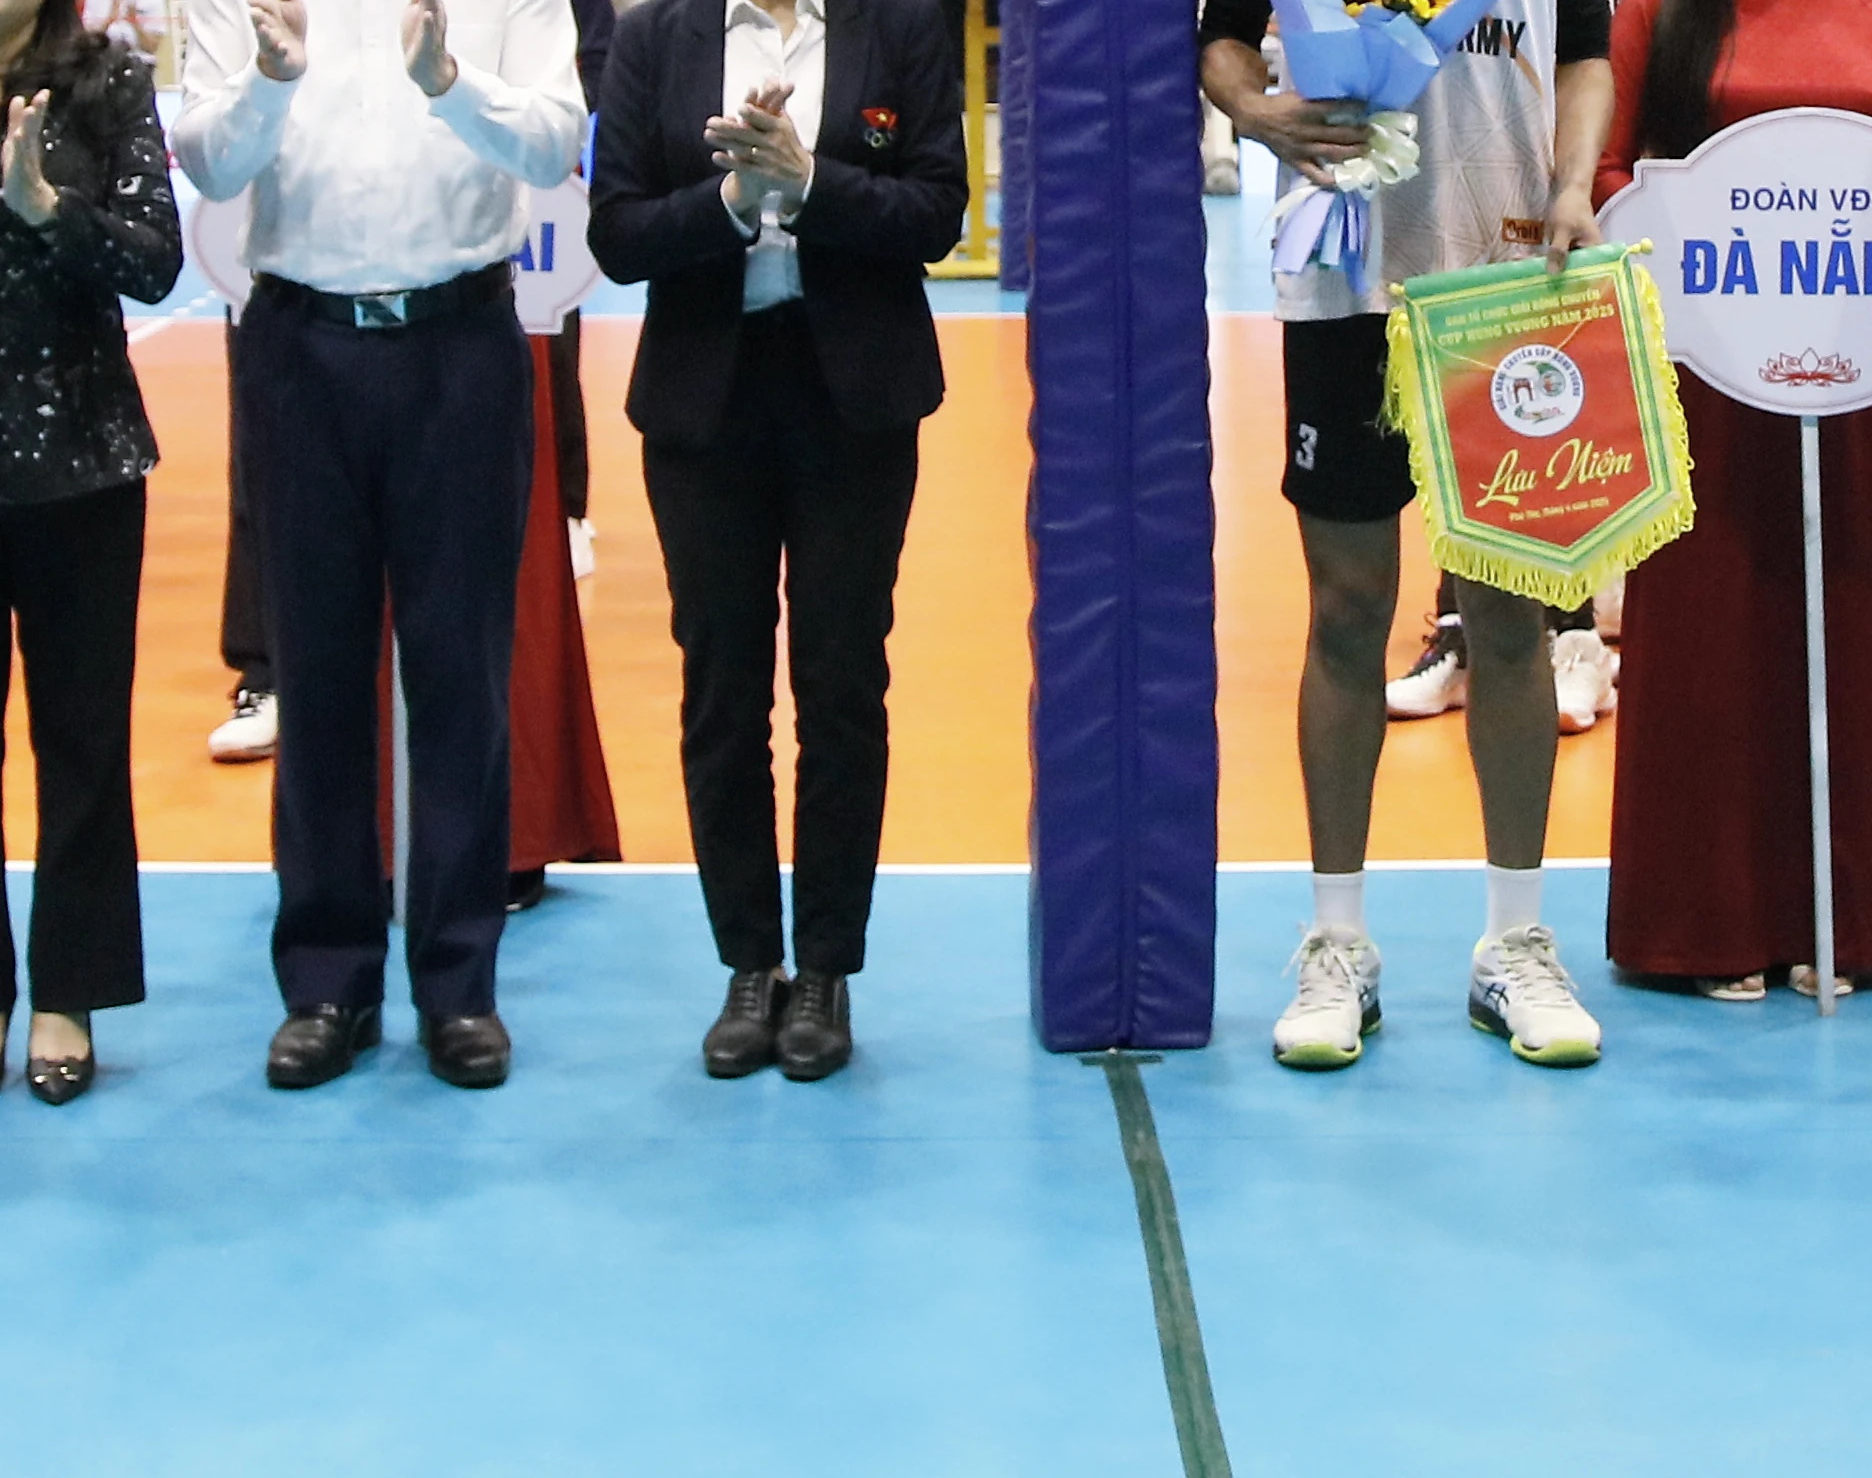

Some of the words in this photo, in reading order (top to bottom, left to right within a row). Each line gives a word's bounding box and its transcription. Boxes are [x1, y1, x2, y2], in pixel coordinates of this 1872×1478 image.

[1730, 182, 1817, 211] ĐOÀN
[1681, 227, 1759, 295] ĐÀ
[1476, 448, 1537, 508] Lưu
[1546, 437, 1633, 491] Niệm
